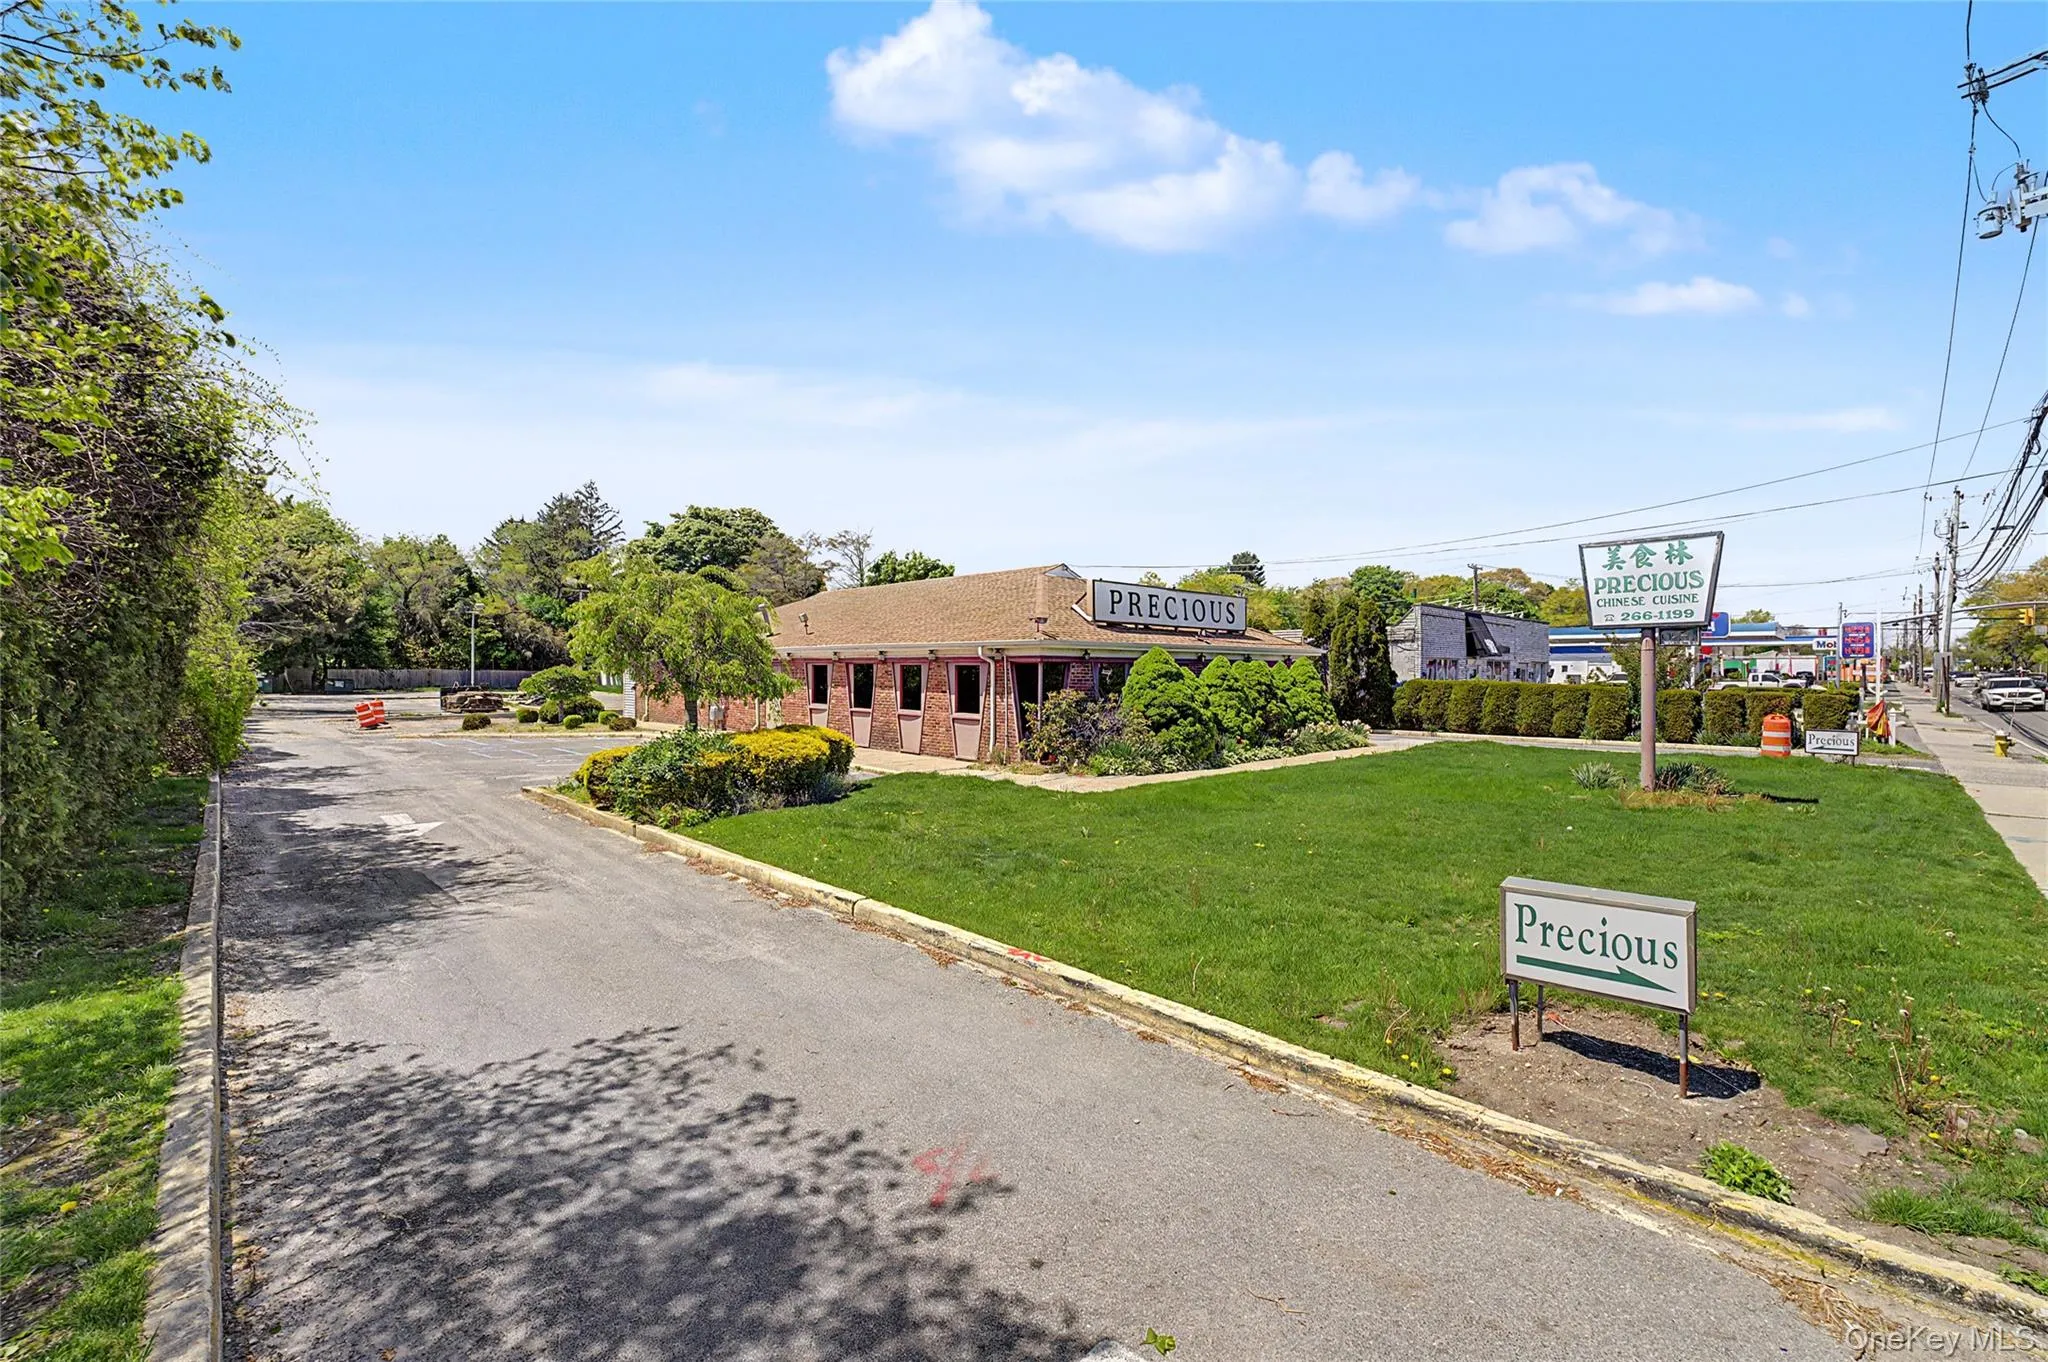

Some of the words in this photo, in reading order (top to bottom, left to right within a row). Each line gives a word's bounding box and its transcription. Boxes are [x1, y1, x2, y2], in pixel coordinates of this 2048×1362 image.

[1602, 541, 1693, 571] 美食林
[1594, 570, 1704, 595] PRECIOUS
[1110, 589, 1235, 624] PRECIOUS
[1596, 596, 1645, 608] CHINESE
[1653, 593, 1699, 605] CUISINE
[1621, 609, 1694, 621] 266-1199
[1808, 733, 1855, 746] Precious
[1514, 903, 1678, 969] Precious
